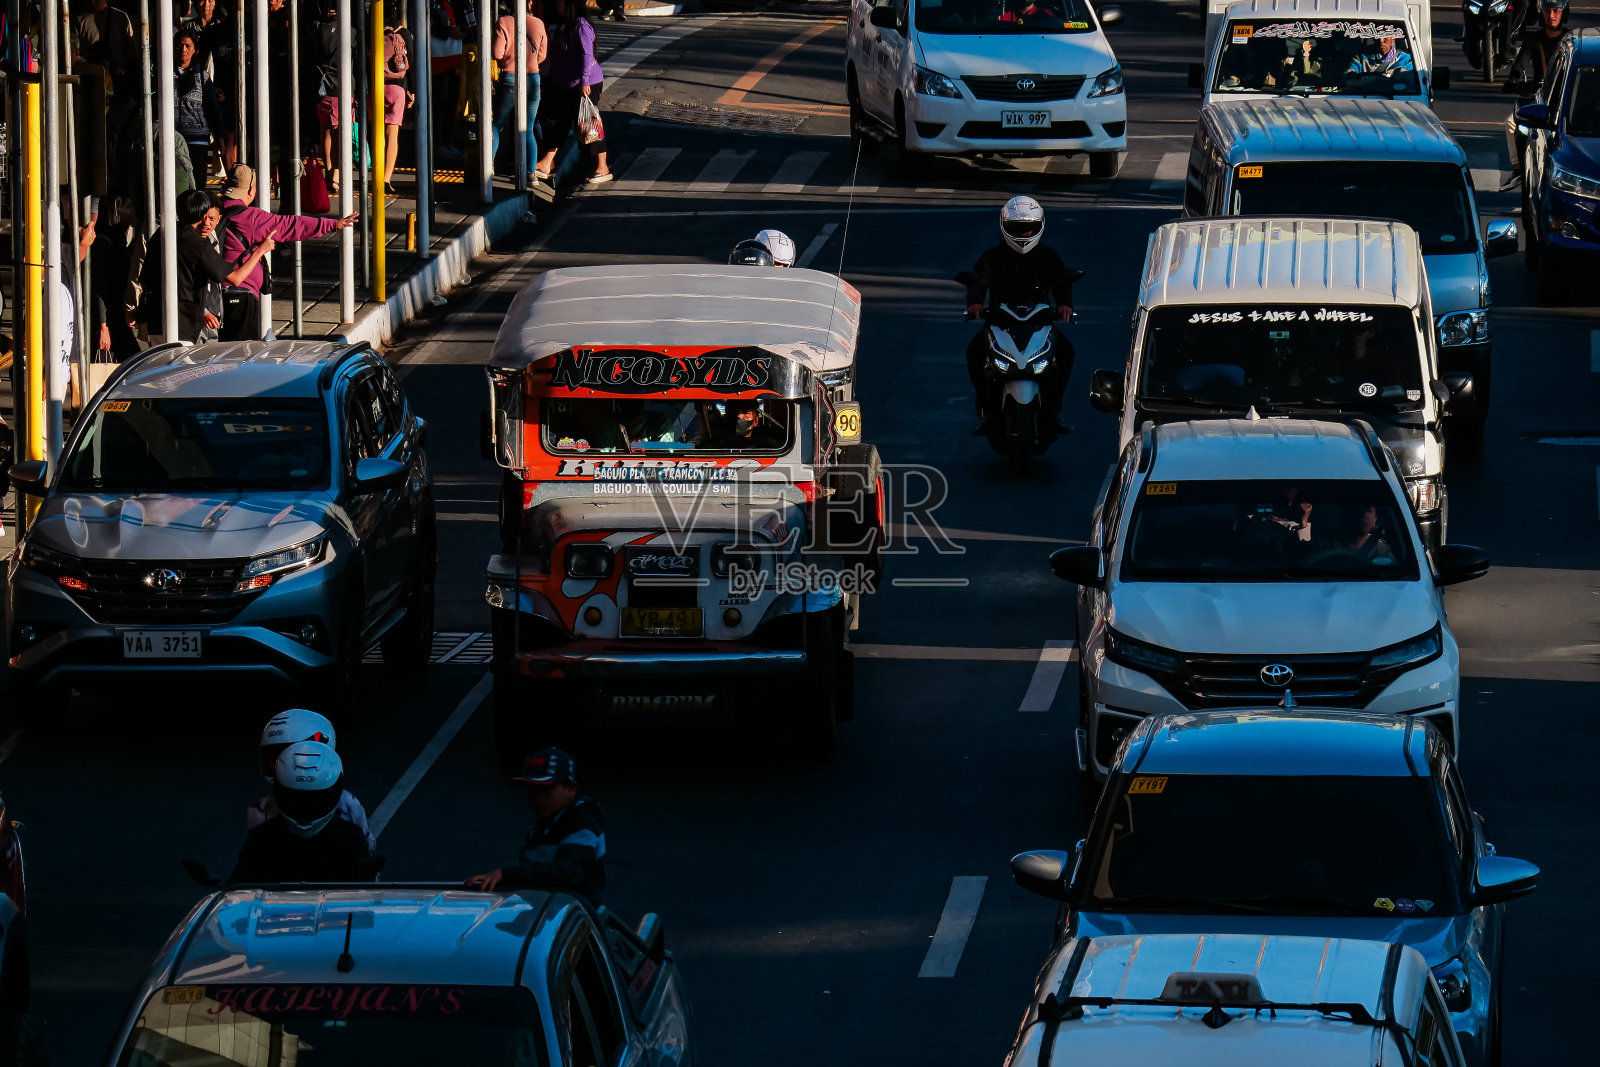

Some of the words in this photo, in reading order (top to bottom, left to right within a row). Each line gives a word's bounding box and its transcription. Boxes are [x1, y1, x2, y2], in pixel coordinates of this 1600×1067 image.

[1006, 114, 1024, 124] WIK
[1029, 114, 1047, 124] 997
[1188, 312, 1243, 323] JESUS
[1299, 310, 1310, 322] A
[1314, 308, 1374, 322] WHEEL
[840, 414, 858, 432] 90
[594, 467, 627, 480] BAGUIO
[629, 467, 656, 480] PLAZA
[593, 483, 632, 494] BAGUIO
[635, 483, 703, 494] TRANCOVILLE
[712, 484, 731, 493] SM
[126, 637, 153, 653] YAA
[163, 637, 199, 653] 3751
[206, 985, 466, 1021] KAILYAN'S
